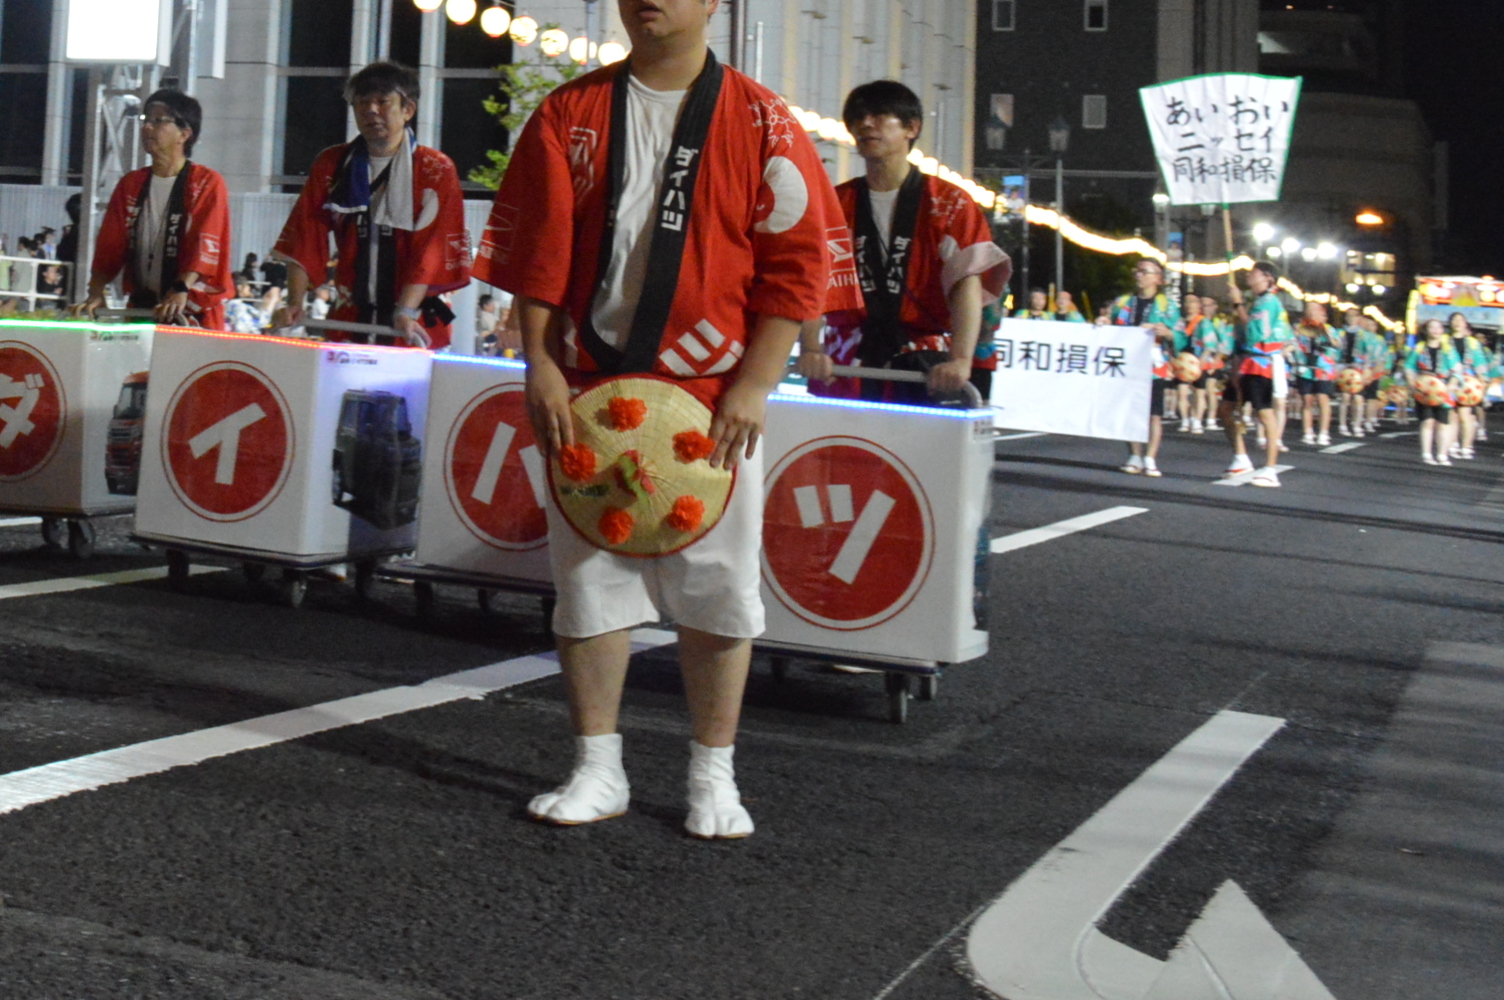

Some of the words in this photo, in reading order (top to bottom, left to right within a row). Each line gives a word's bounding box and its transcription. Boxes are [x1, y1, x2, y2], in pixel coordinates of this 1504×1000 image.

[1166, 95, 1289, 126] あいおい
[1176, 126, 1273, 153] ニッセイ
[660, 145, 700, 232] ダイハツ
[1173, 154, 1277, 184] 同和損保
[885, 235, 912, 294] ダイハツ
[188, 402, 268, 486] イ
[470, 420, 546, 509] ハ
[793, 484, 897, 586] ツ
